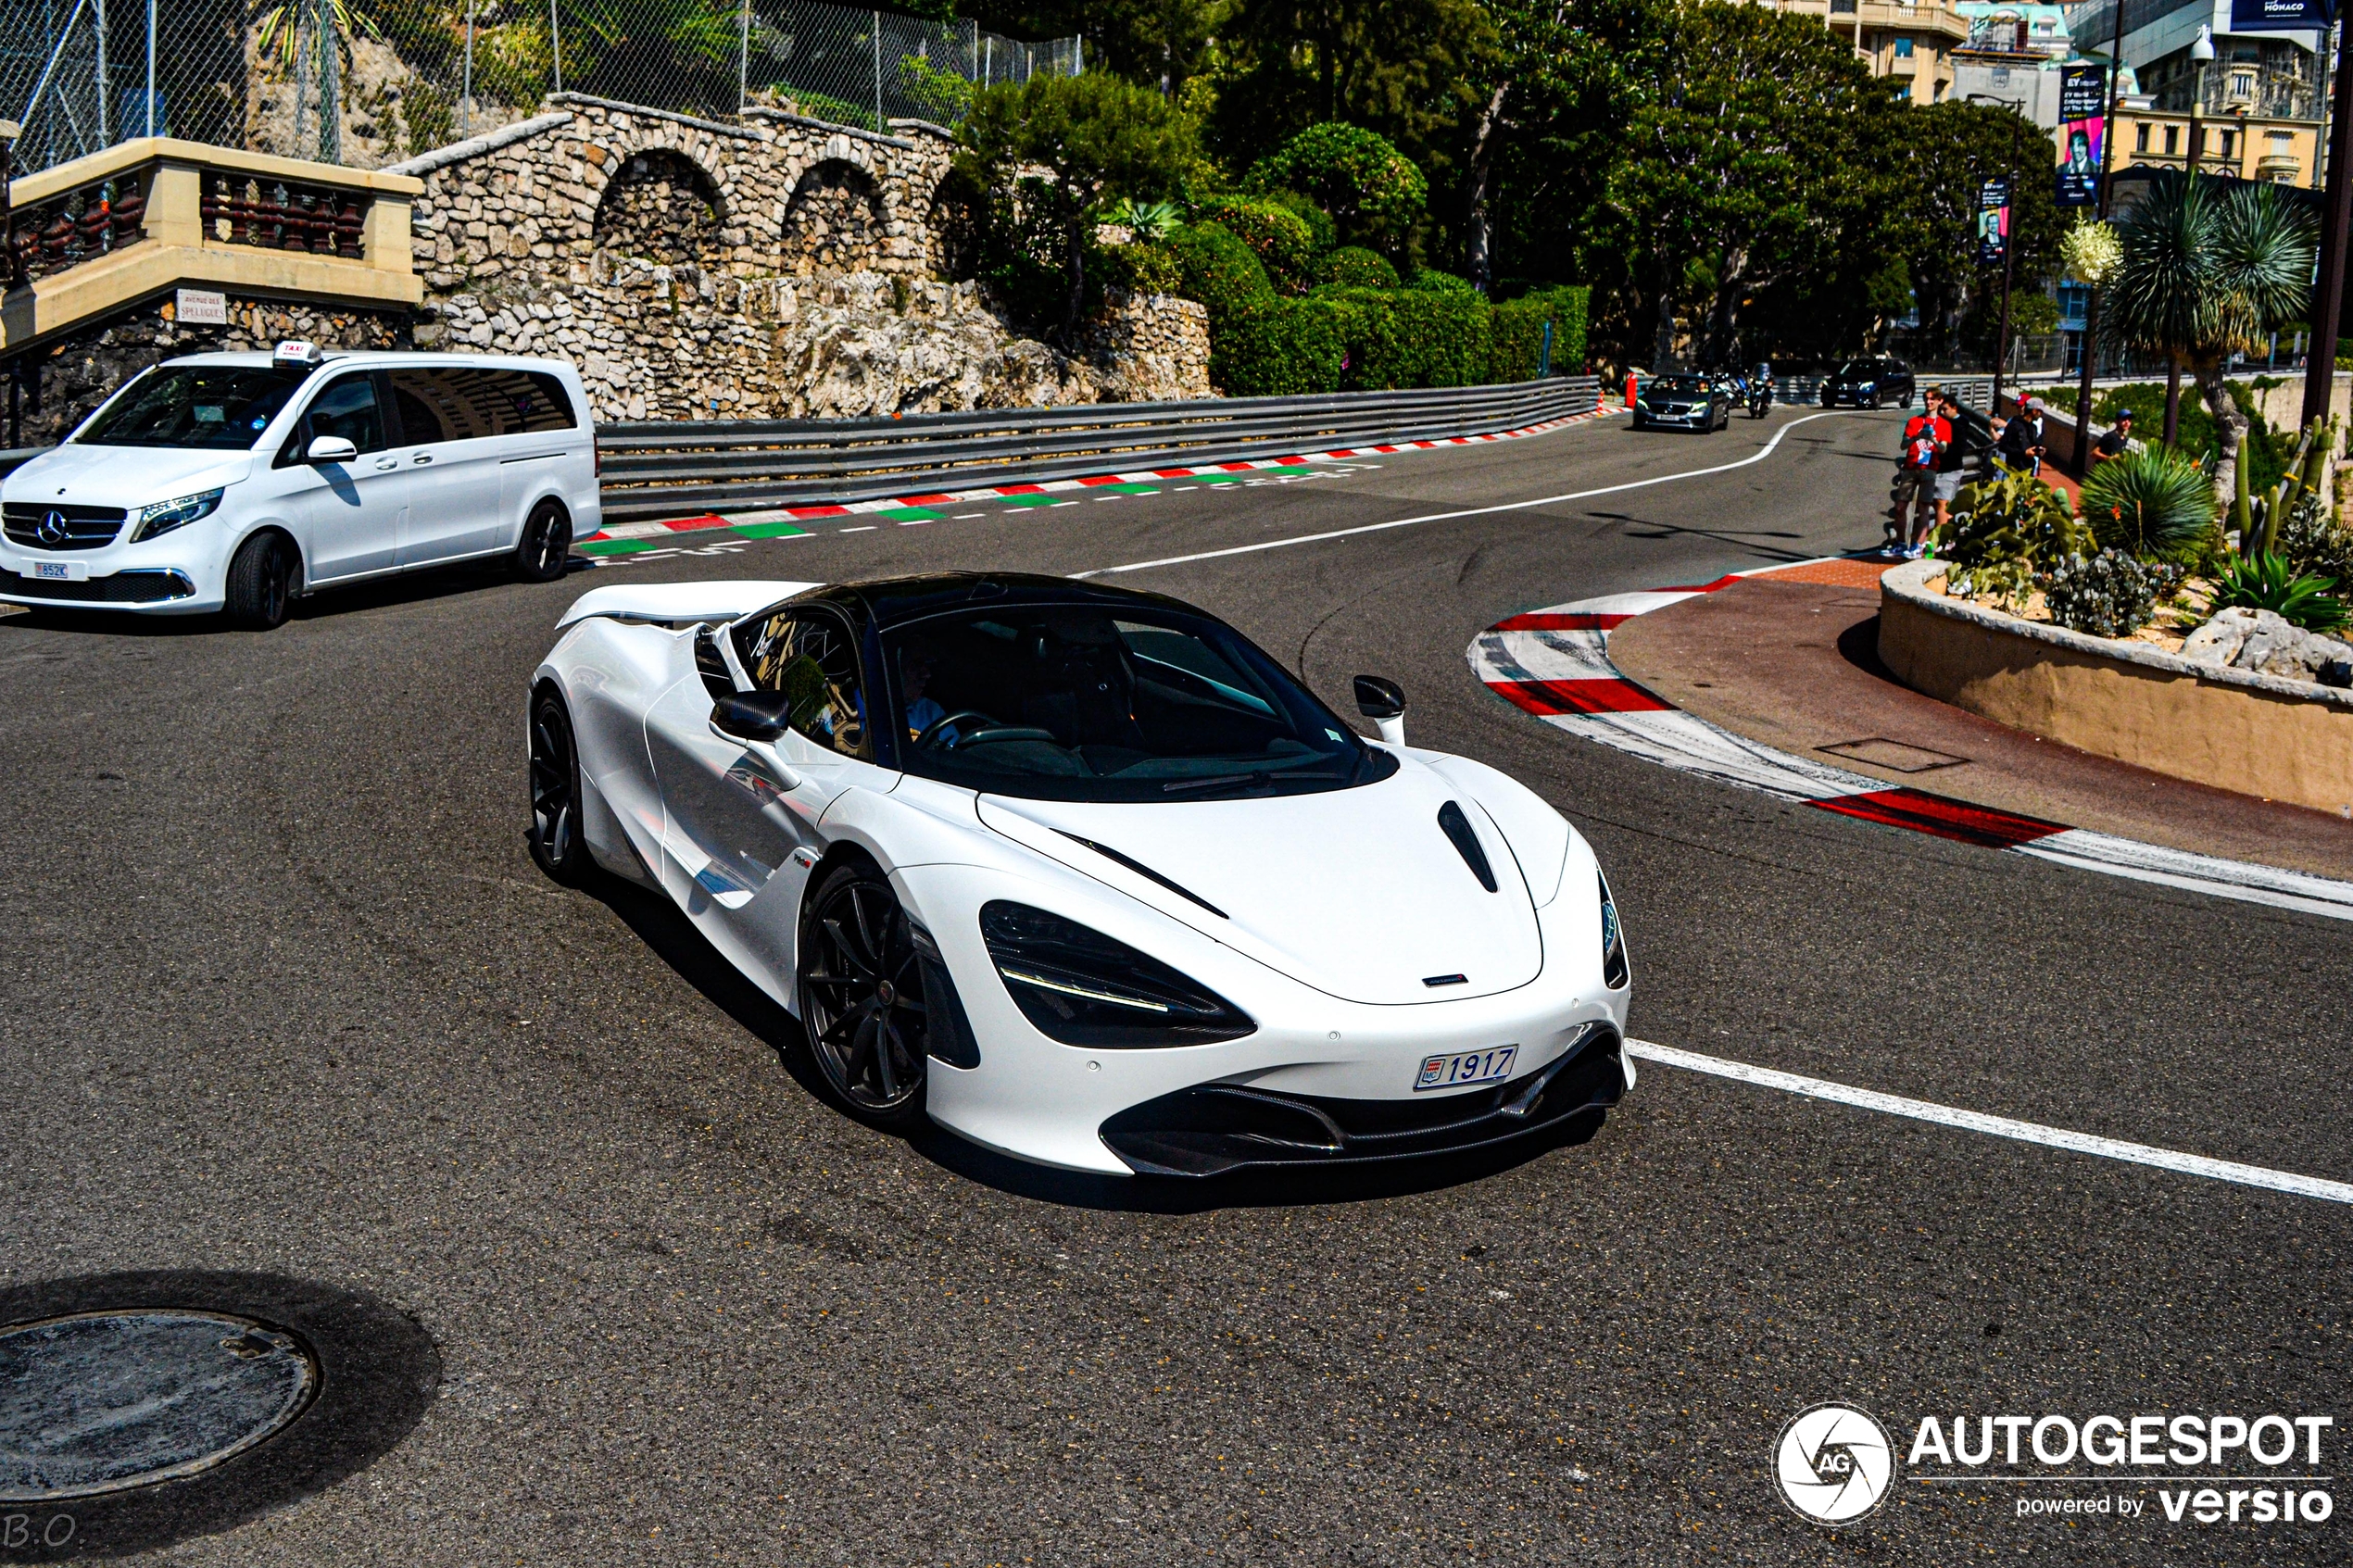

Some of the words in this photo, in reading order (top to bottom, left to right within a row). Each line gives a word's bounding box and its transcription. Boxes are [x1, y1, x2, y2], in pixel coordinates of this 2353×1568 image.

[2264, 3, 2304, 11] MONACO
[181, 307, 225, 318] SPELUGUES
[1449, 1048, 1514, 1081] 1917
